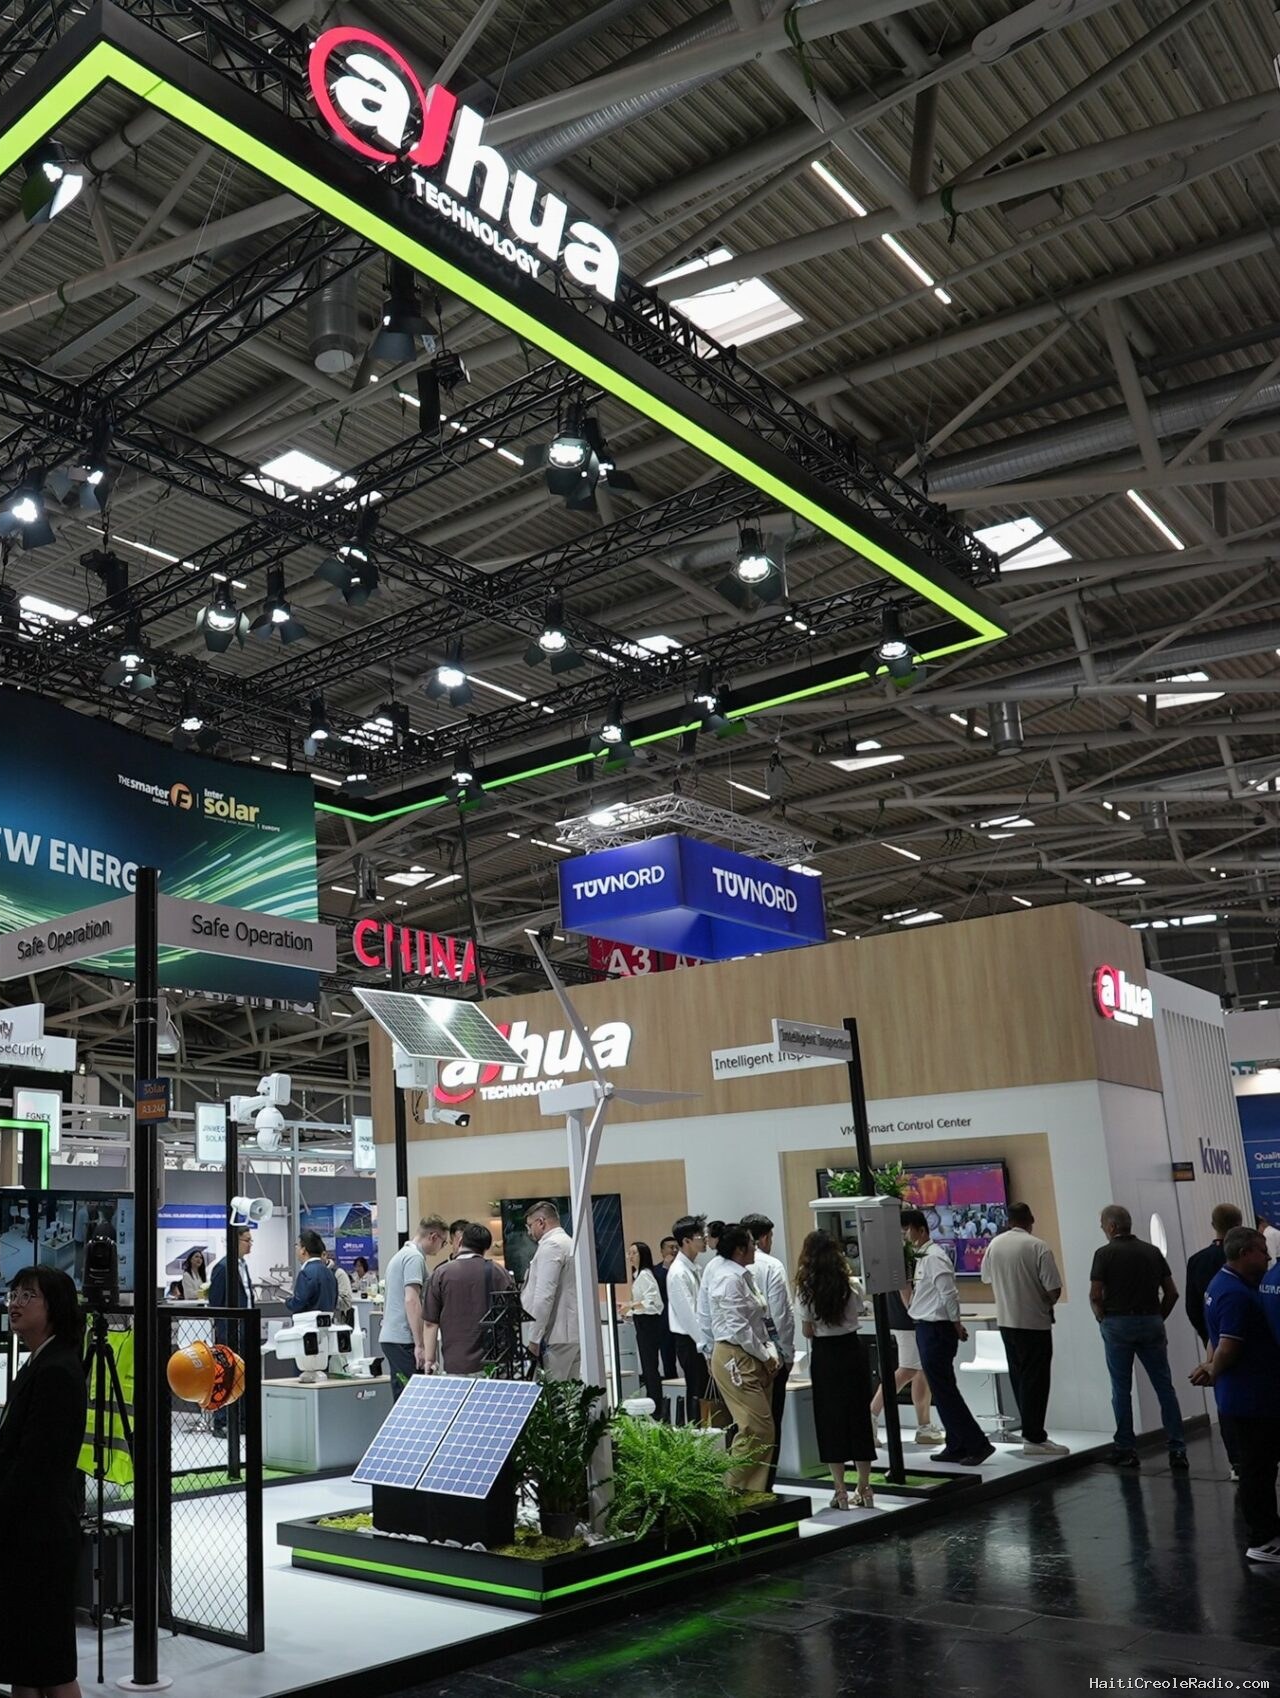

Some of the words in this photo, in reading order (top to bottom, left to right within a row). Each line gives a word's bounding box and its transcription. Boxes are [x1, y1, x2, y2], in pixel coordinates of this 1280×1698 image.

[410, 172, 541, 279] TECHNOLOGY
[204, 797, 260, 823] solar
[49, 838, 161, 894] ENERG
[17, 938, 45, 960] Safe
[47, 917, 112, 952] Operation
[192, 914, 230, 938] Safe
[235, 921, 313, 952] Operation
[352, 918, 486, 986] CHINA
[608, 946, 652, 976] A3
[780, 1028, 817, 1047] Intelligent
[714, 1052, 774, 1073] Intelligent
[868, 1123, 894, 1134] Smart
[897, 1119, 934, 1132] Control
[937, 1117, 972, 1129] Center
[1199, 1137, 1232, 1176] kiwa
